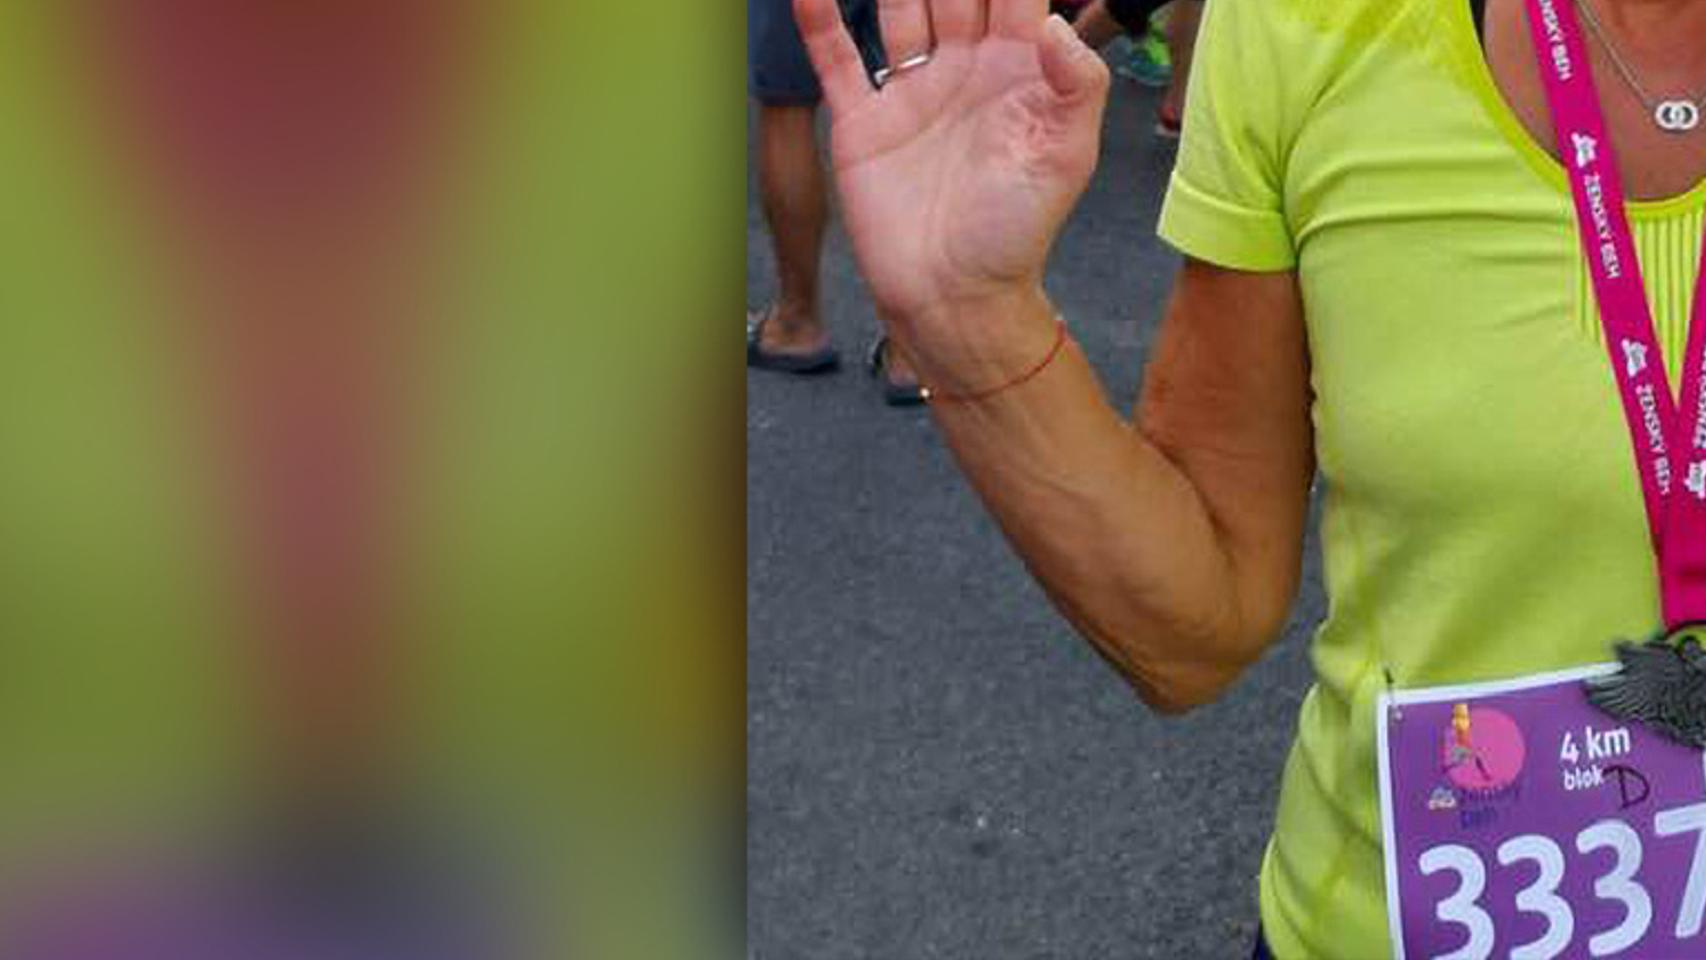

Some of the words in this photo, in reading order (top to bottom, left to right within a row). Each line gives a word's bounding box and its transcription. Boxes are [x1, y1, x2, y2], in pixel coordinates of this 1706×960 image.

[1560, 732, 1580, 764] 4
[1585, 725, 1631, 760] km
[1563, 764, 1604, 791] blok
